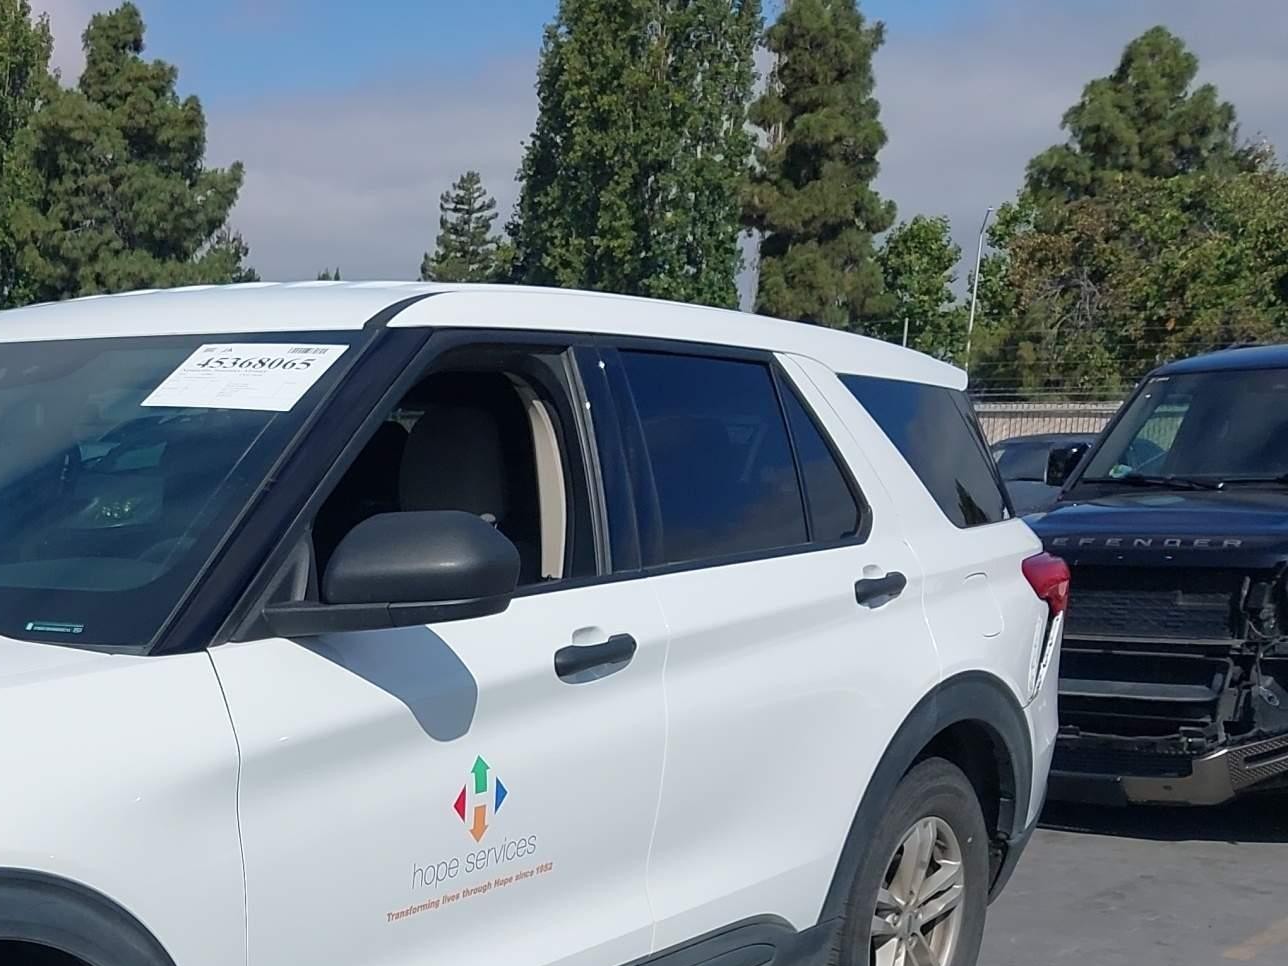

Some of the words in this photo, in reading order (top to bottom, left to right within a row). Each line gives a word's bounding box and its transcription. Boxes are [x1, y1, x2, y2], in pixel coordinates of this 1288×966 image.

[196, 357, 316, 370] 45368065
[1052, 538, 1243, 548] EFENDER
[412, 857, 459, 889] hope
[465, 834, 537, 873] services
[386, 899, 440, 922] Transforming
[442, 892, 460, 905] lives
[462, 882, 492, 899] through
[493, 874, 513, 888] Hope
[515, 869, 534, 882] since
